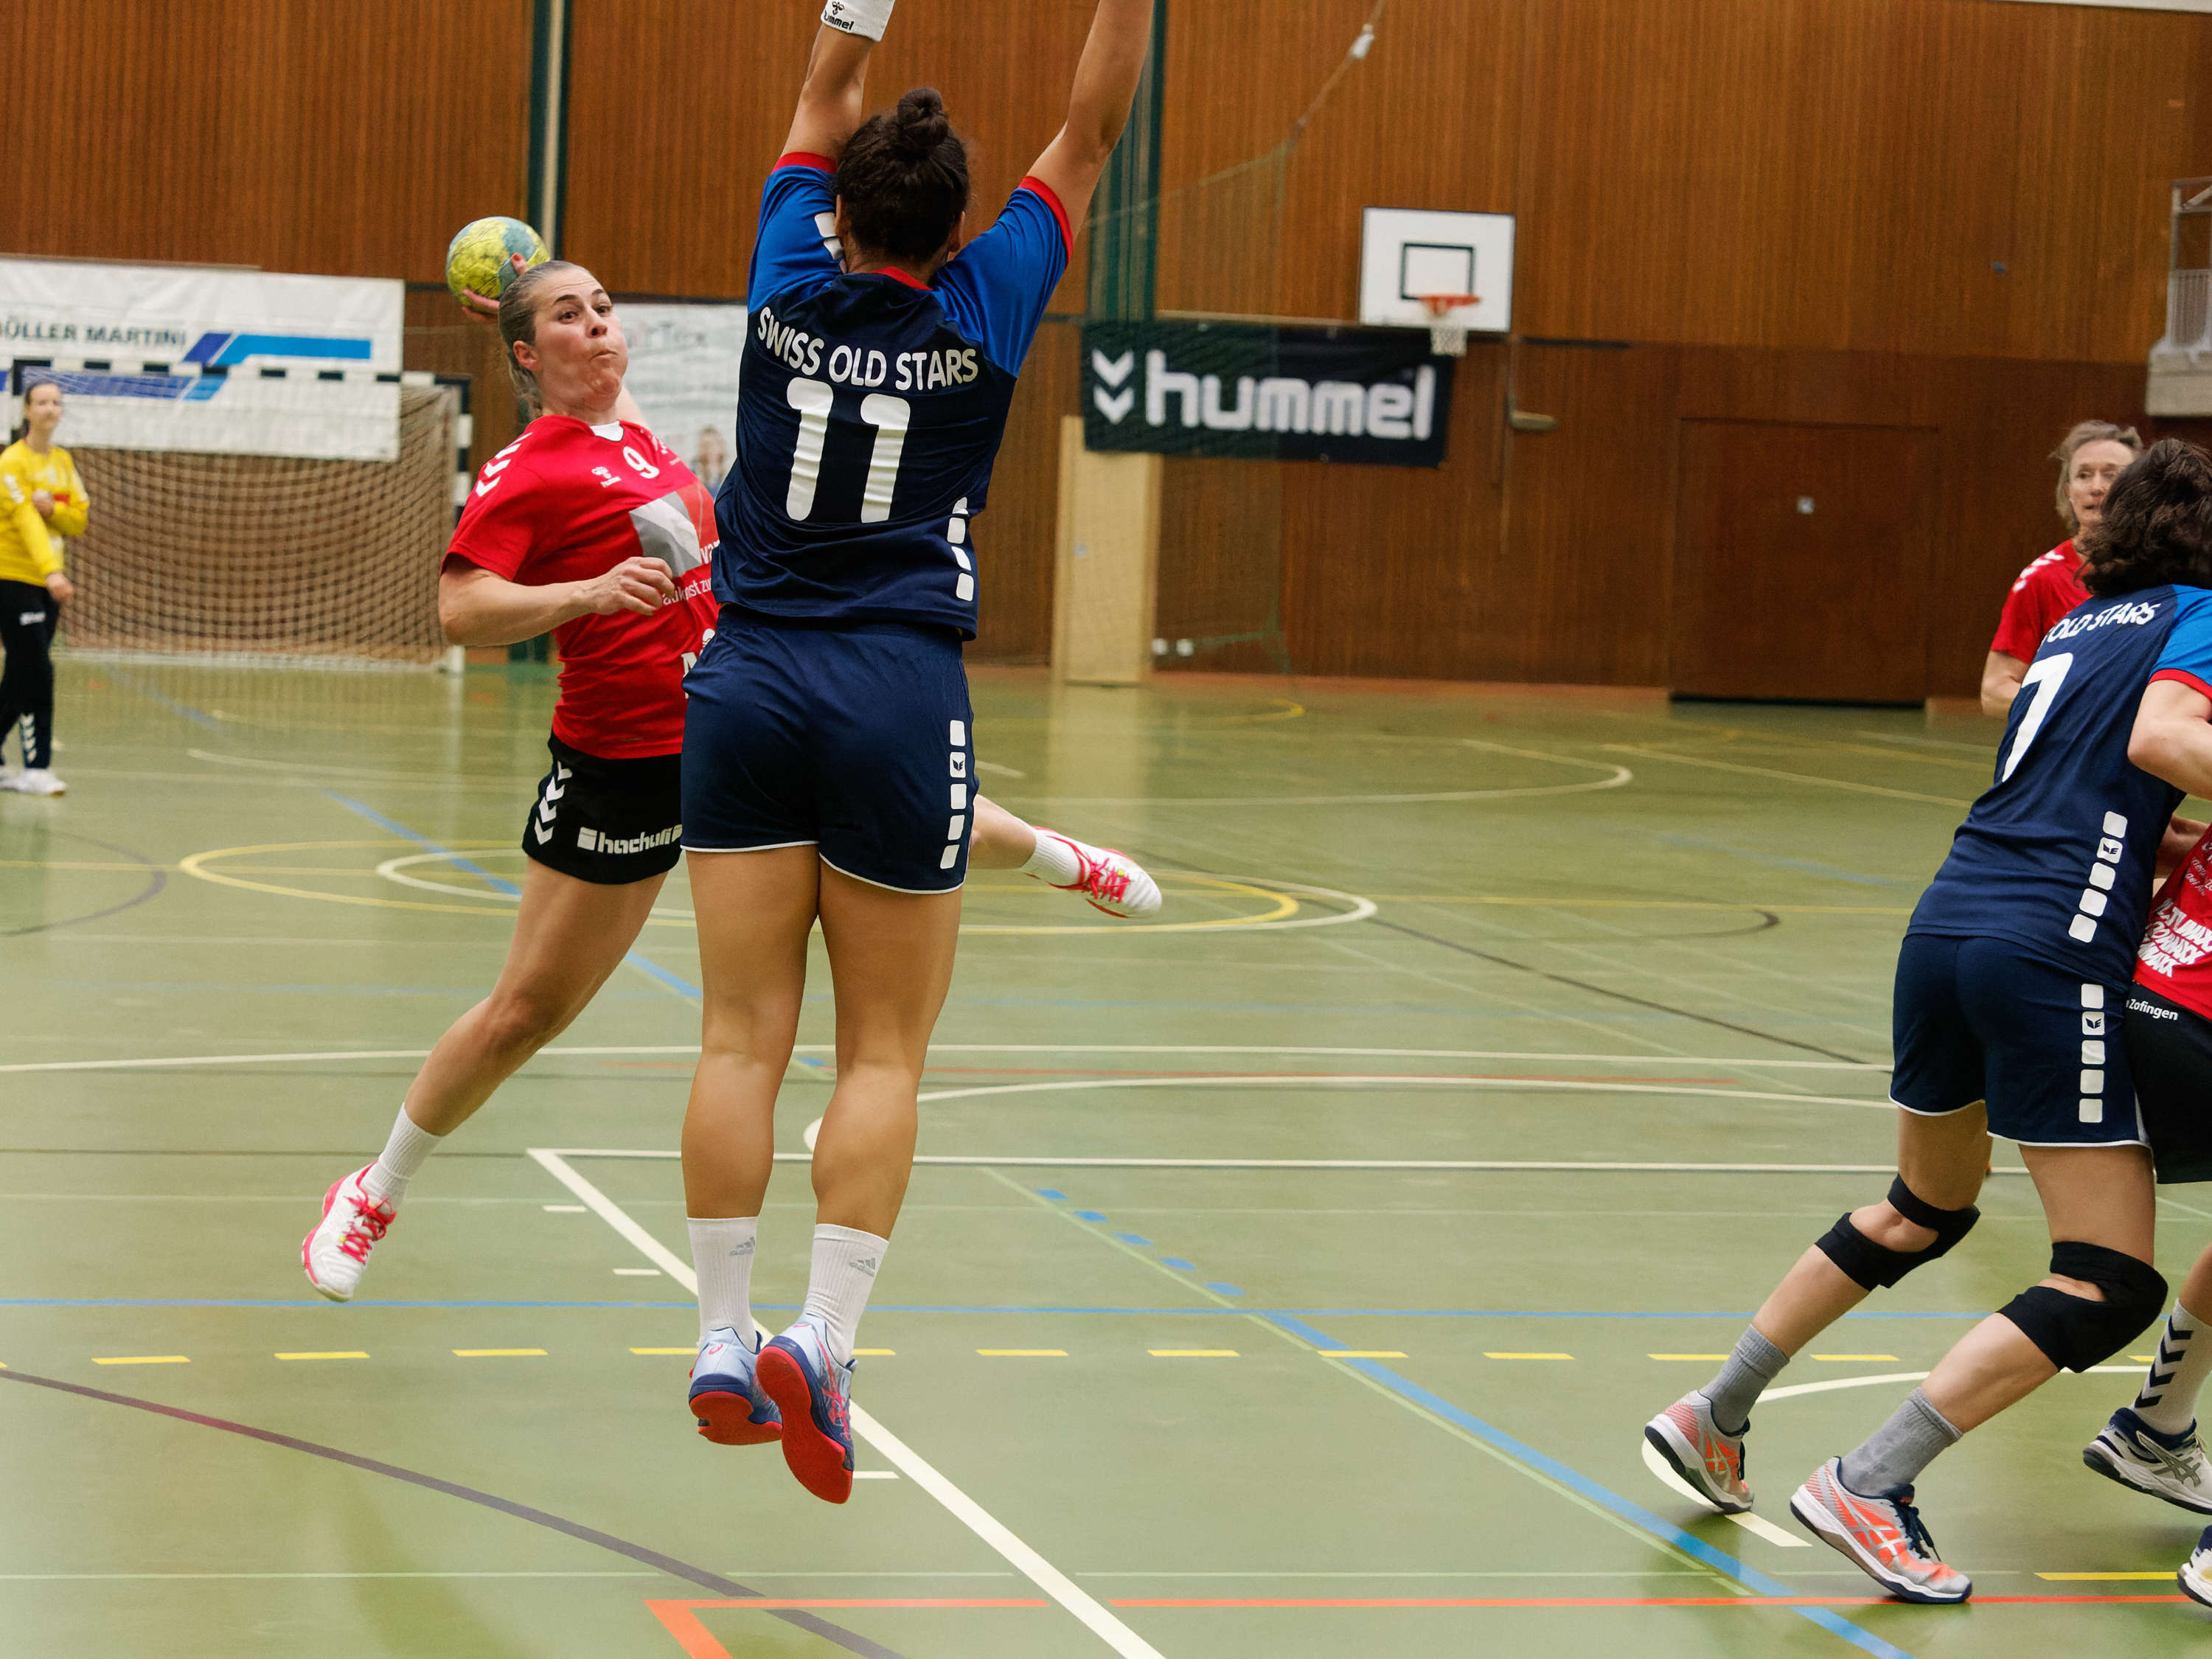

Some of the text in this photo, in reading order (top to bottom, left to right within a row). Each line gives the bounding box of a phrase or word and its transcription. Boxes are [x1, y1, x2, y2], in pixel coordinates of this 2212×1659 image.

[824, 10, 854, 30] ummel
[85, 323, 186, 346] MARTINI
[757, 306, 825, 376] SWISS
[829, 344, 886, 387] OLD
[895, 348, 978, 391] STARS
[1145, 349, 1436, 441] hummel
[623, 446, 660, 479] 9
[786, 377, 911, 524] 11
[2047, 613, 2093, 643] OLD
[2087, 602, 2161, 631] STARS
[2002, 653, 2073, 782] 7
[2129, 998, 2179, 1021] Zofingen
